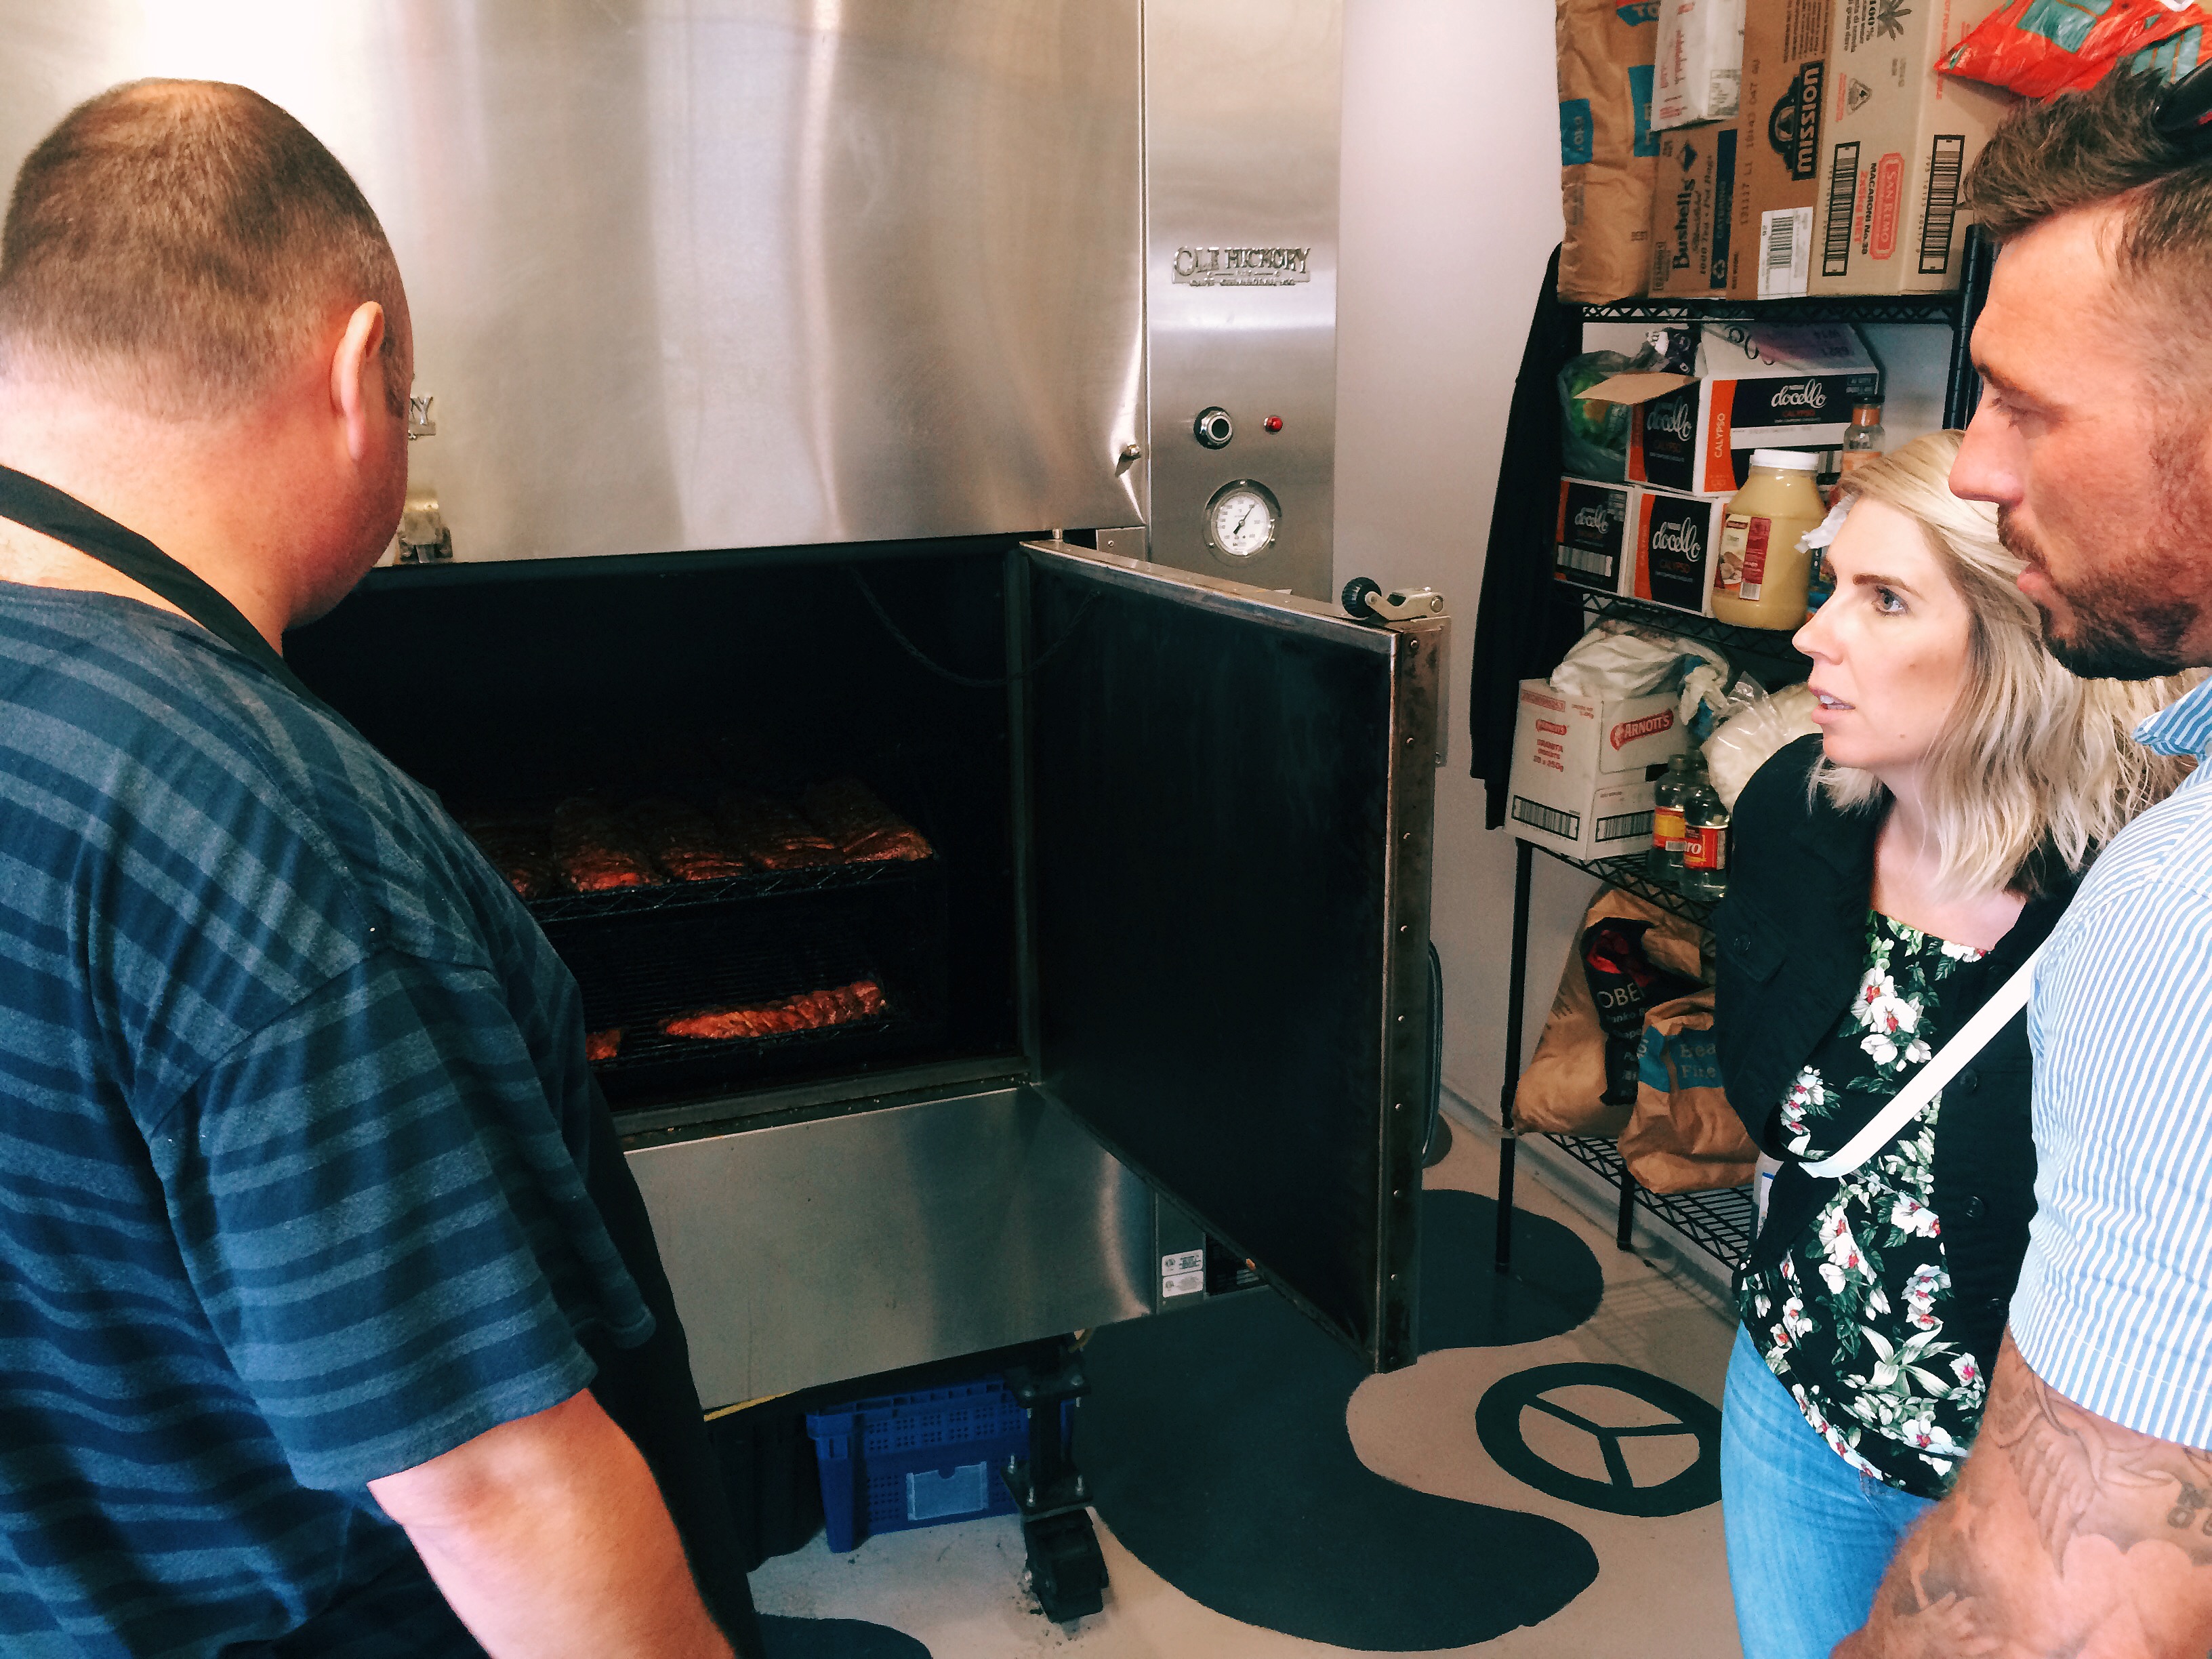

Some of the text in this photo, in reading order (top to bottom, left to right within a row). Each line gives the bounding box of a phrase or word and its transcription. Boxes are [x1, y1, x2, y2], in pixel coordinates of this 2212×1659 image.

[1797, 68, 1820, 173] mission
[1864, 163, 1877, 222] MACARONI
[1880, 170, 1896, 244] SAN REMO
[1224, 247, 1311, 274] HICKORY
[1771, 377, 1828, 409] docello
[1713, 412, 1727, 459] CALYPSO
[1652, 516, 1702, 562] docello
